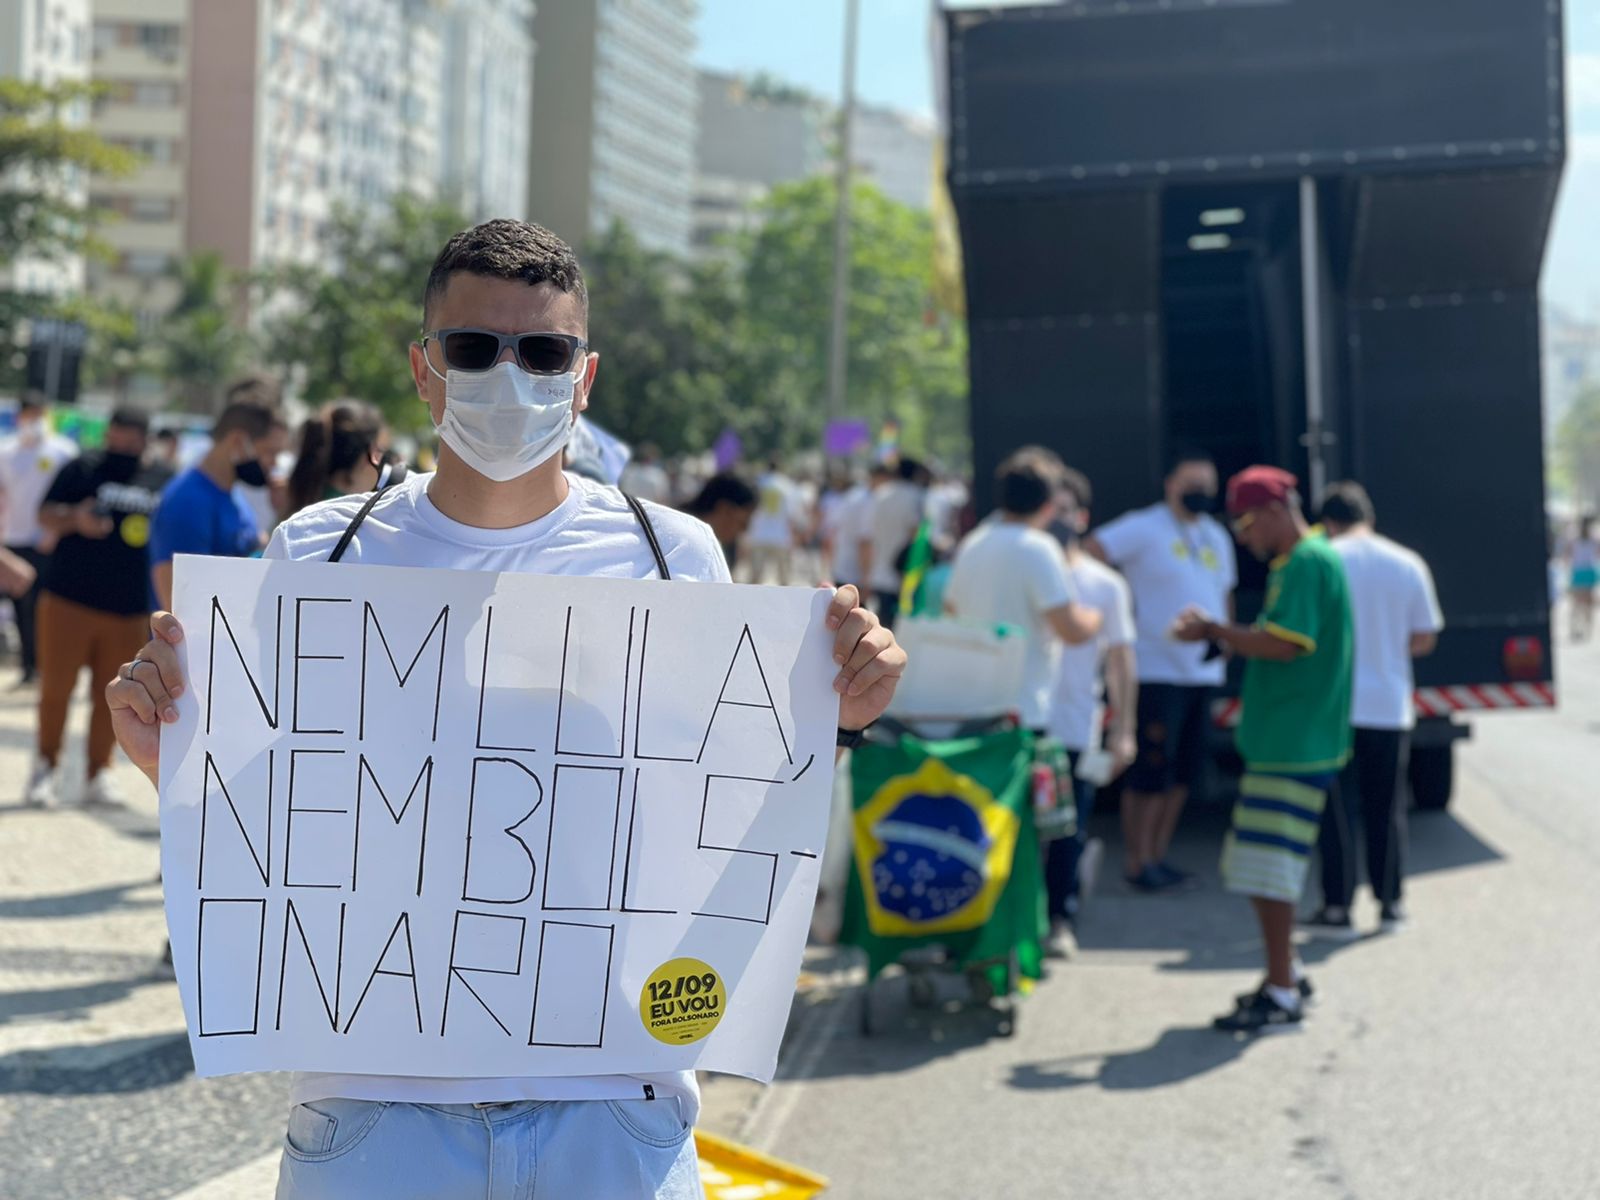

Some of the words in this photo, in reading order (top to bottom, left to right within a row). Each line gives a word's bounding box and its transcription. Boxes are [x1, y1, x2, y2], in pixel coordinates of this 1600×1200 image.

[206, 595, 450, 742] NEM
[476, 606, 815, 782] LULA,
[198, 749, 435, 897] NEM
[461, 757, 817, 925] BOLS-
[198, 897, 615, 1048] ONARO
[648, 973, 716, 1001] 12/09
[651, 1001, 674, 1019] EU
[677, 995, 718, 1013] VOU
[651, 1020, 671, 1028] FORA
[673, 1012, 719, 1024] BOLSONARO
